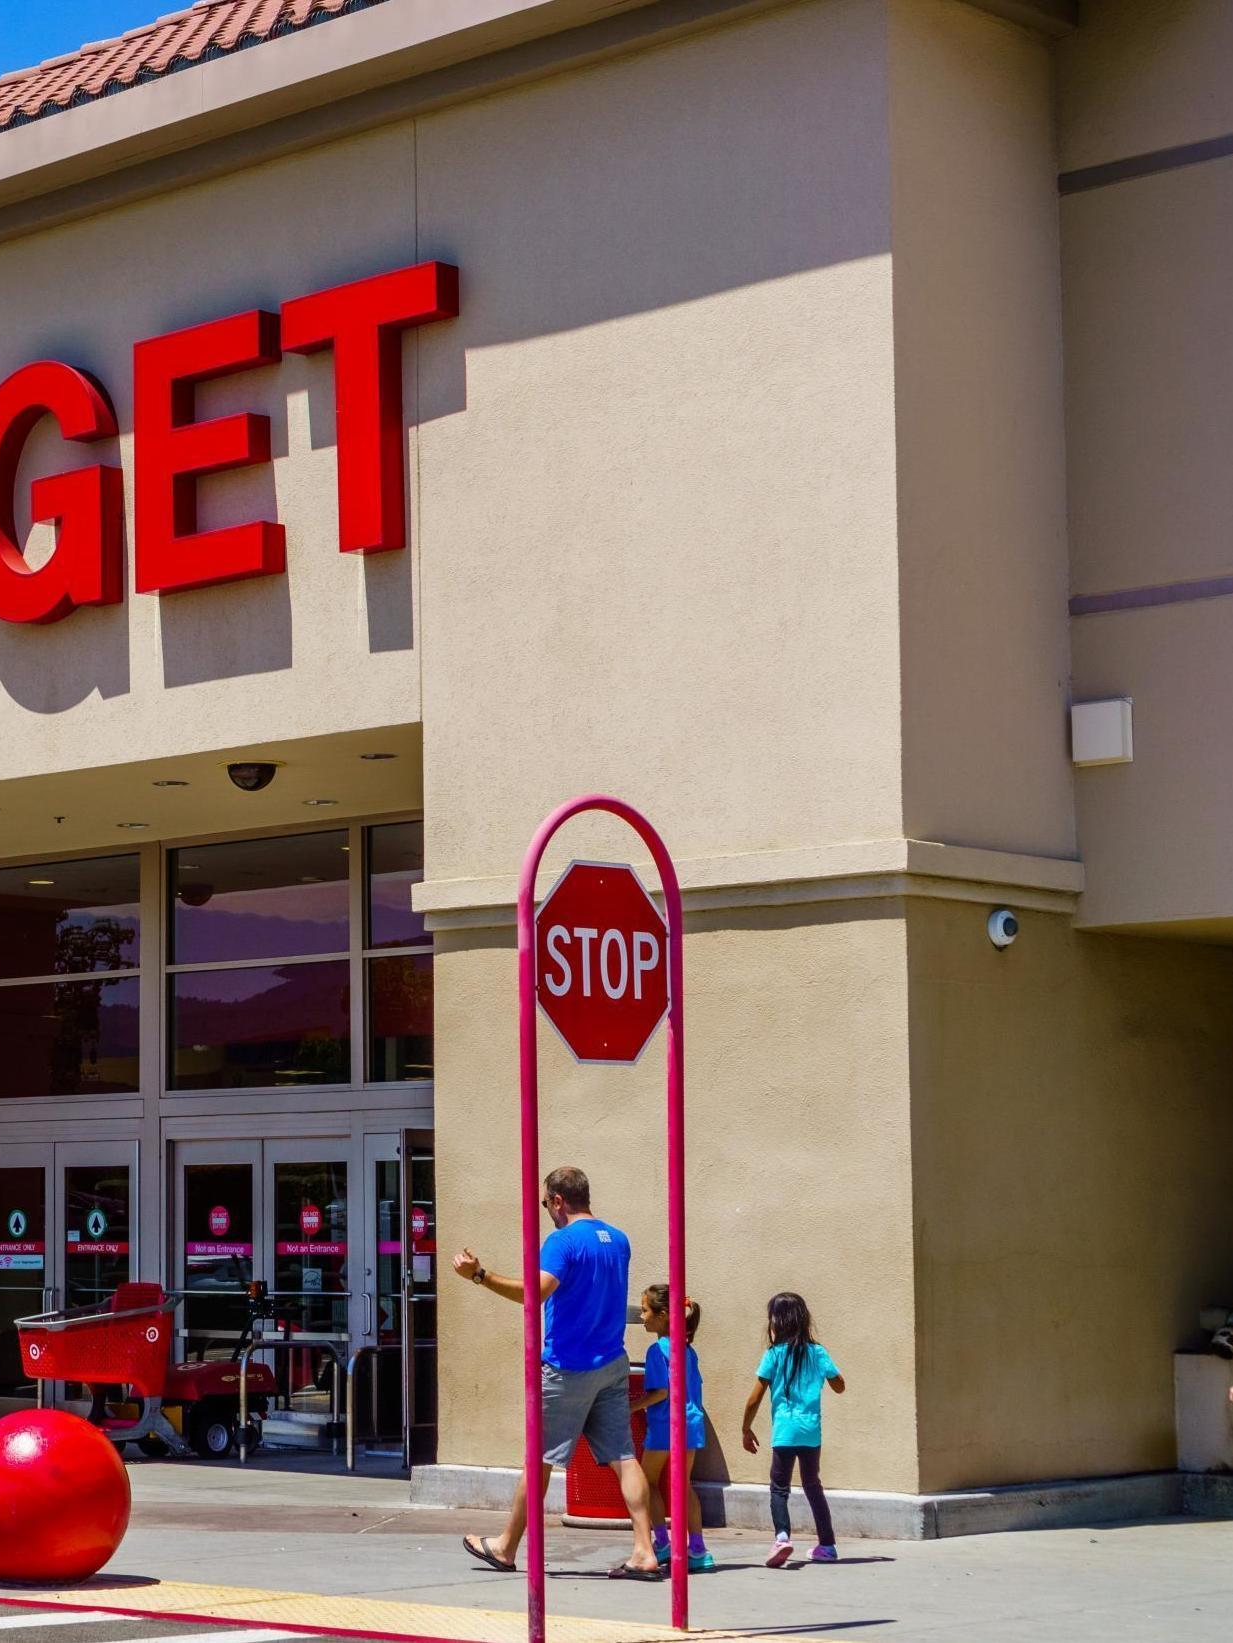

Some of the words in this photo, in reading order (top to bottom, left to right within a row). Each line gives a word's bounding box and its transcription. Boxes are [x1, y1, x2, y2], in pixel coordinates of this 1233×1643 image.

[545, 925, 659, 1000] STOP
[77, 1244, 104, 1252] ENTRANCE
[106, 1244, 118, 1252] ONLY
[195, 1244, 207, 1253] Not
[217, 1245, 244, 1253] Entrance
[287, 1244, 299, 1252] Not
[310, 1244, 339, 1252] Entrance
